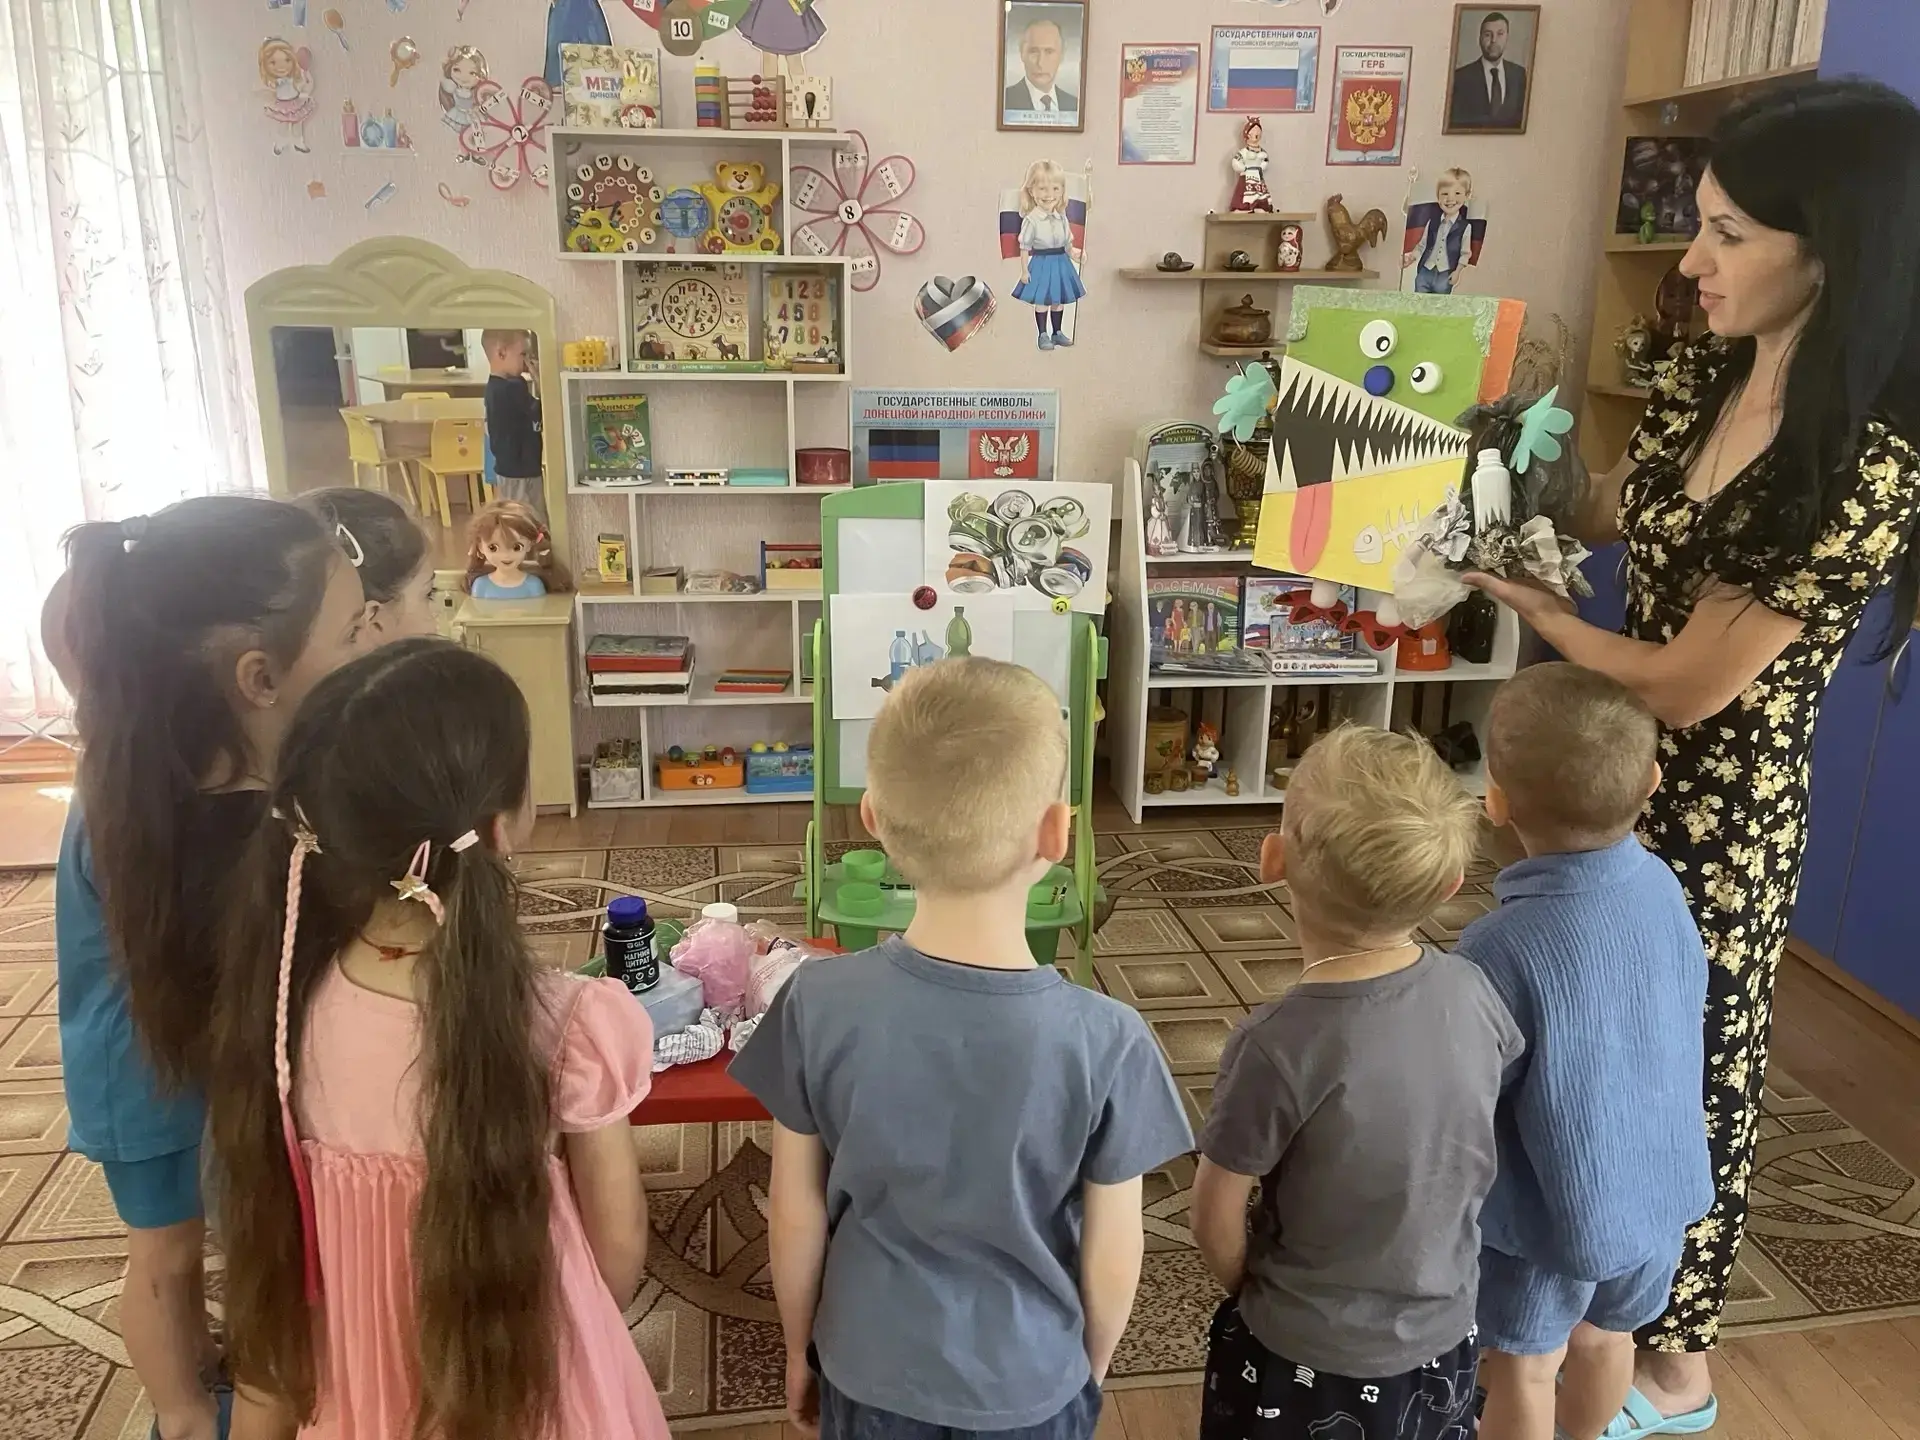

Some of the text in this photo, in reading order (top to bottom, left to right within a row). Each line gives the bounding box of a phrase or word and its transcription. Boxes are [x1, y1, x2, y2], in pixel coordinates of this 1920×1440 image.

[673, 21, 690, 37] 10
[1215, 30, 1318, 39] ГОСУДАРСТВЕННЫЙ ФЛАГ
[1361, 60, 1385, 69] ГЕРБ
[513, 127, 527, 141] 2
[598, 157, 610, 167] 12
[581, 167, 591, 178] 11
[640, 170, 649, 180] 2
[571, 188, 582, 198] 10
[652, 192, 661, 201] 3
[844, 206, 855, 219] 8
[644, 231, 652, 240] 5
[626, 242, 634, 251] 6
[678, 286, 686, 295] 11
[687, 282, 698, 292] 12
[785, 281, 793, 299] 1
[798, 280, 809, 299] 2
[669, 296, 680, 304] 10
[707, 293, 714, 302] 2
[711, 304, 718, 313] 3
[777, 303, 789, 321] 4
[707, 316, 714, 324] 4
[699, 323, 706, 332] 5
[778, 325, 789, 344] 7
[877, 396, 1032, 407] ГОСУДАРСТВЕННЫЕ СИМВОЛЫ
[863, 408, 1046, 420] ДОНЕЦКОЙ НАРОДНОЙ РЕСПУБЛИКИ
[1153, 580, 1226, 598] О СЕМЬЕ
[625, 957, 650, 968] ЦИТРАТ
[1360, 1385, 1380, 1403] 23
